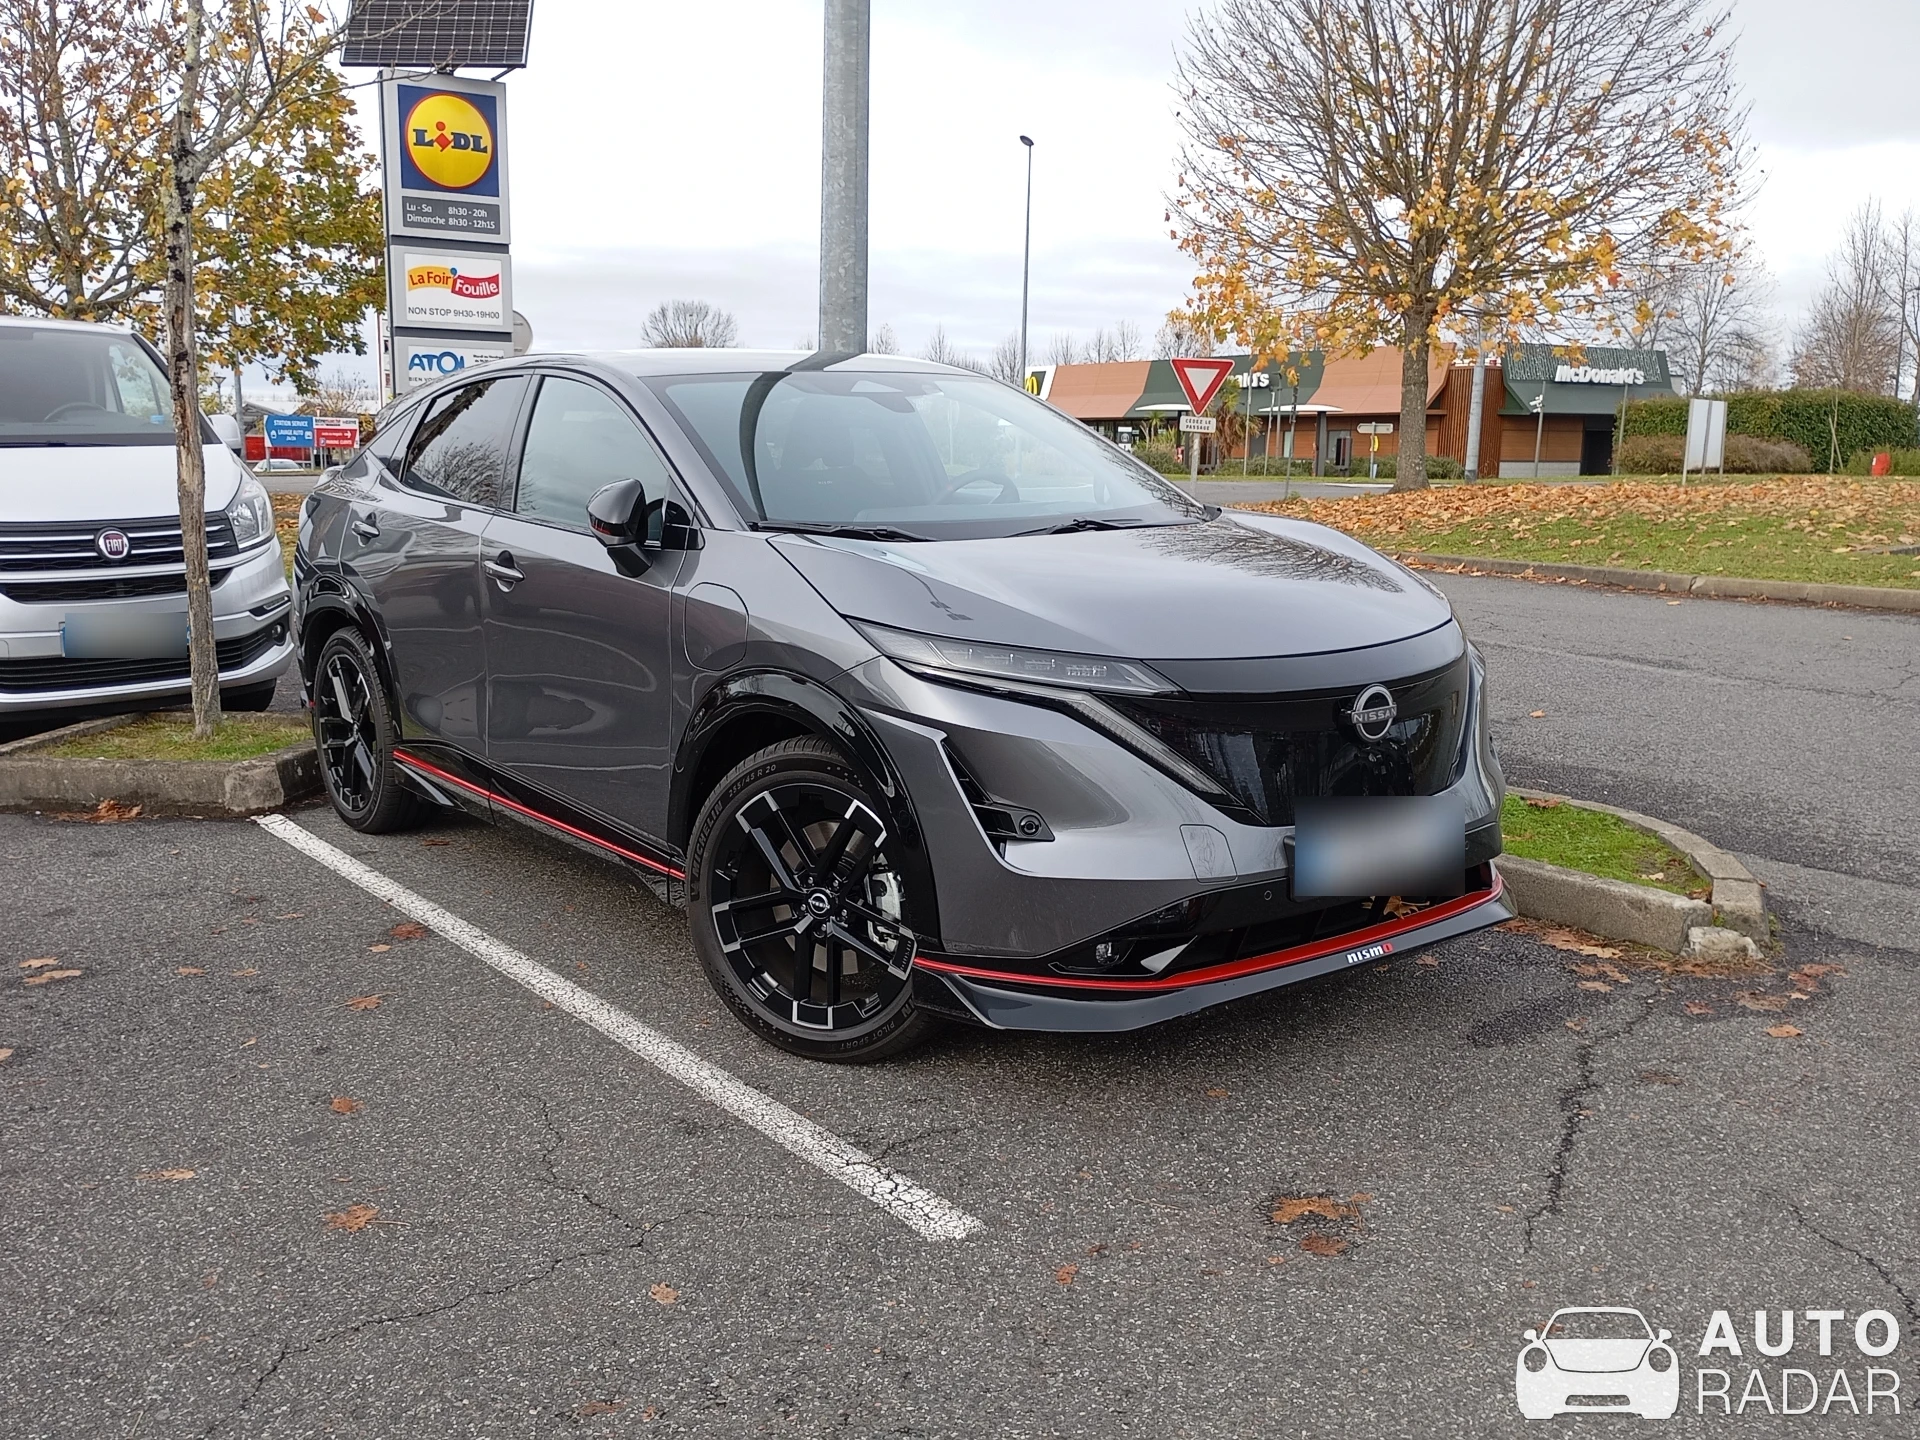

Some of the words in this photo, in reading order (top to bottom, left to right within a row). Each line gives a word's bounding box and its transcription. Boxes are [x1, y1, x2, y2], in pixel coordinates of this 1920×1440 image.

[406, 203, 417, 211] Lu
[422, 204, 432, 213] Sa
[448, 206, 467, 216] 8h30
[473, 209, 487, 218] 20h
[407, 214, 446, 225] Dimanche
[448, 217, 468, 227] 8h30
[473, 220, 496, 229] 12h15
[409, 273, 425, 286] La
[455, 279, 499, 296] Fouille
[408, 306, 427, 315] NON
[428, 308, 452, 317] STOP
[453, 309, 500, 319] 9H30-19H00
[1555, 365, 1644, 384] McDonald's
[106, 539, 122, 551] FIAT
[1353, 707, 1397, 722] NISSAN
[728, 772, 755, 798] 255/45
[757, 768, 763, 777] R
[765, 764, 777, 774] 20
[692, 799, 723, 878] MICHELIN
[872, 1020, 895, 1040] PILOT
[840, 1036, 869, 1050] SPORT
